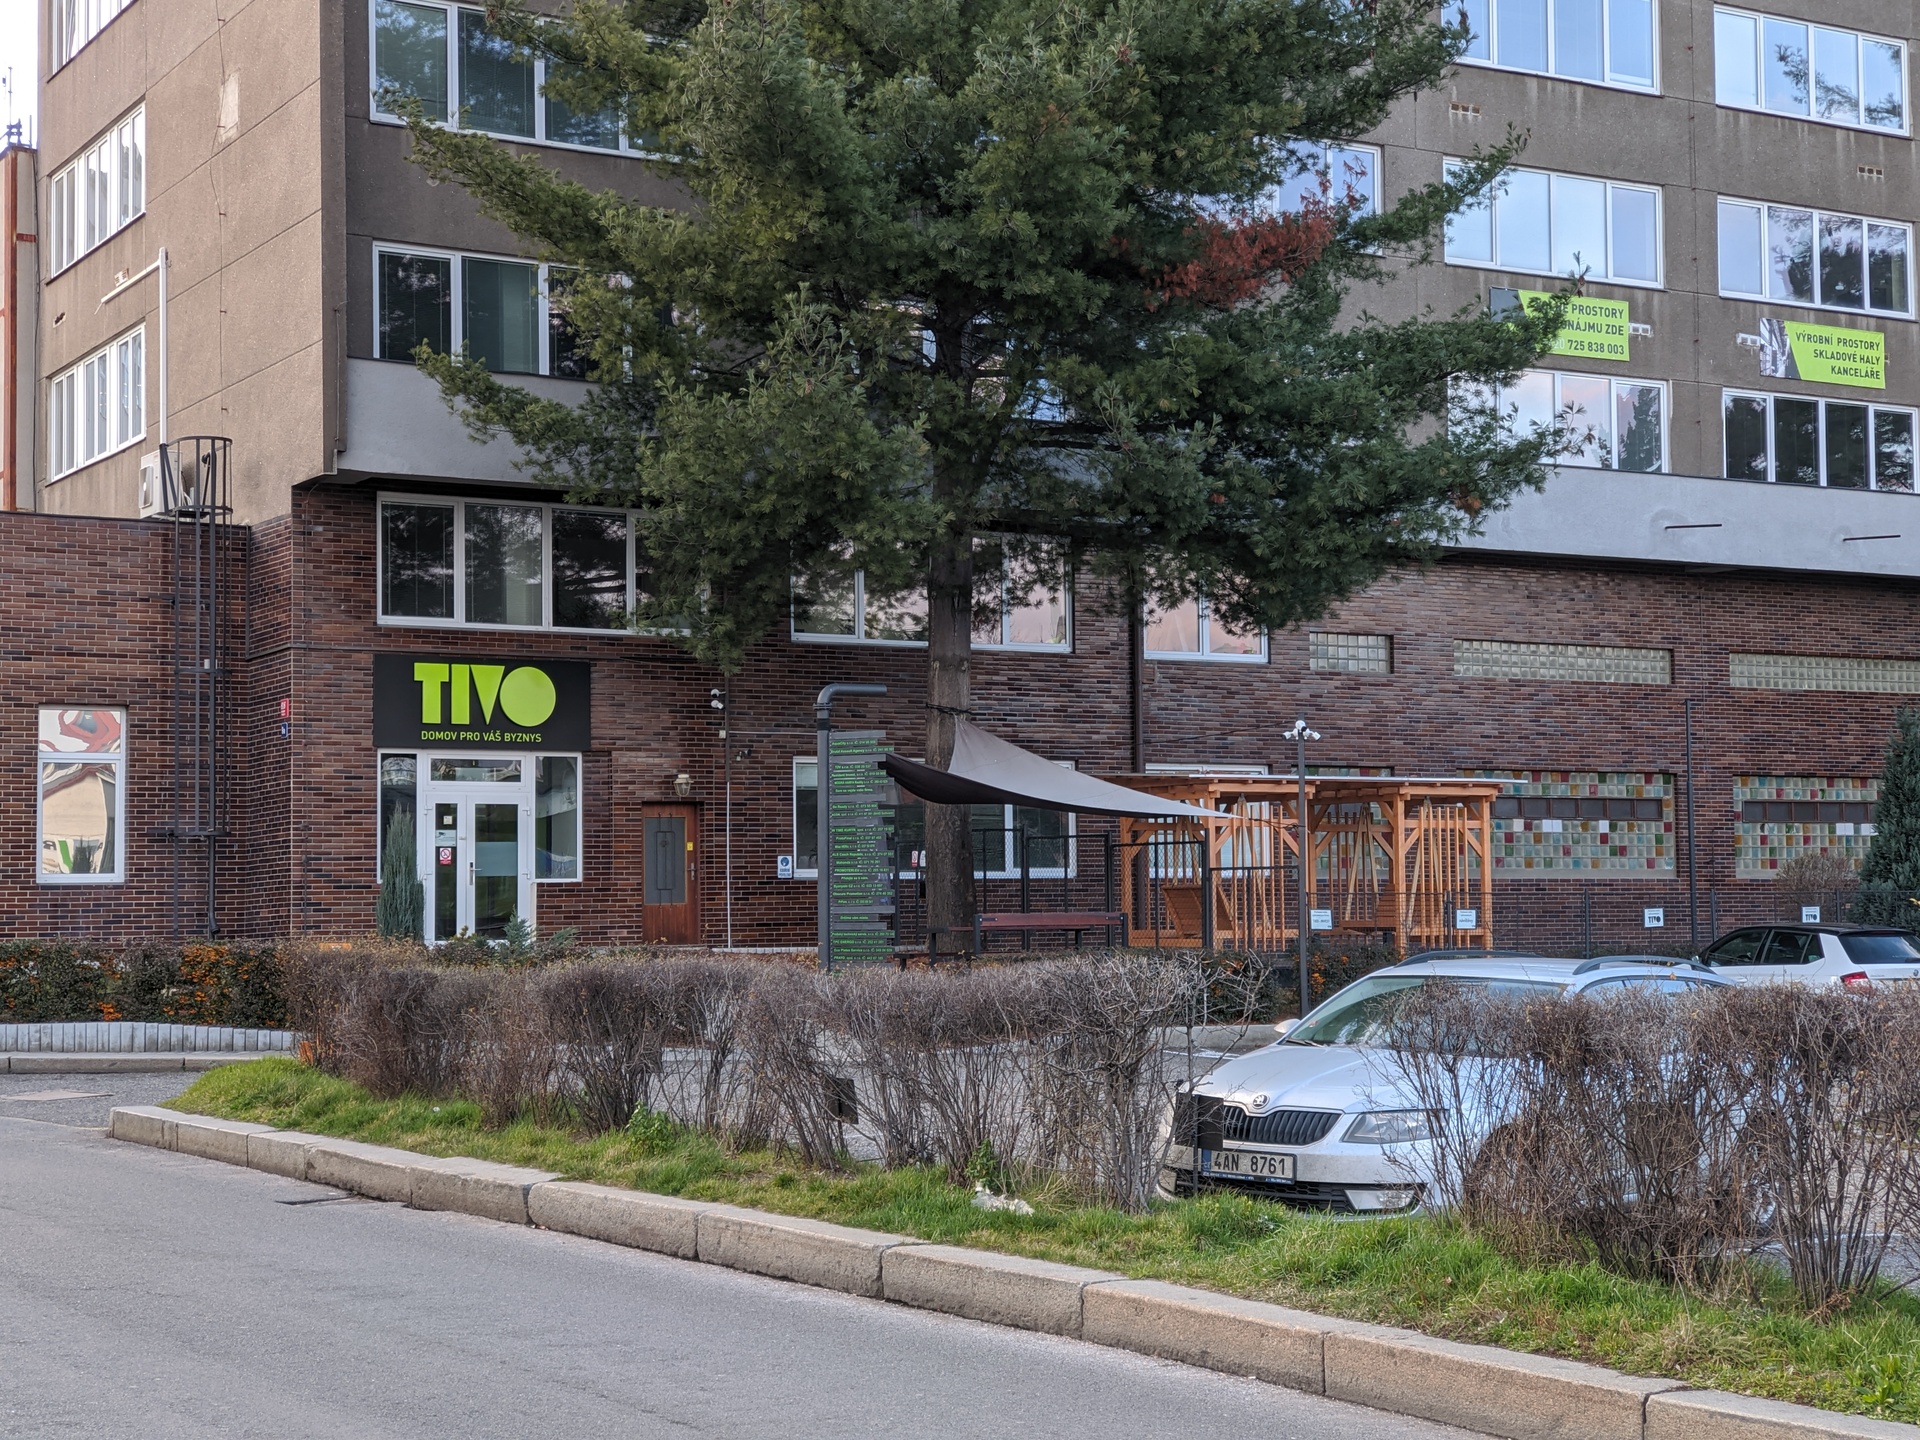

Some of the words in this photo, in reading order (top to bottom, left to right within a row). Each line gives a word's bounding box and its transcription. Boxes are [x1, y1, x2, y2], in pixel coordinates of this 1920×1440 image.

[1572, 304, 1624, 319] PROSTORY
[1605, 324, 1624, 336] ZDE
[1567, 339, 1586, 352] 725
[1587, 342, 1605, 354] 838
[1607, 343, 1625, 356] 003
[1796, 330, 1833, 345] VÝROBNÍ
[1836, 337, 1881, 352] PROSTORY
[1813, 348, 1858, 363] SKLADOVÉ
[1859, 354, 1881, 366] HALY
[1831, 366, 1880, 379] KANCELÁŘE
[413, 662, 557, 728] TIVO
[421, 730, 458, 741] DOMOV
[459, 731, 481, 742] PRO
[482, 729, 502, 743] VÁŠ
[503, 732, 542, 743] BYZNYS
[1214, 1153, 1239, 1171] 4AN
[1250, 1155, 1285, 1175] 8761
